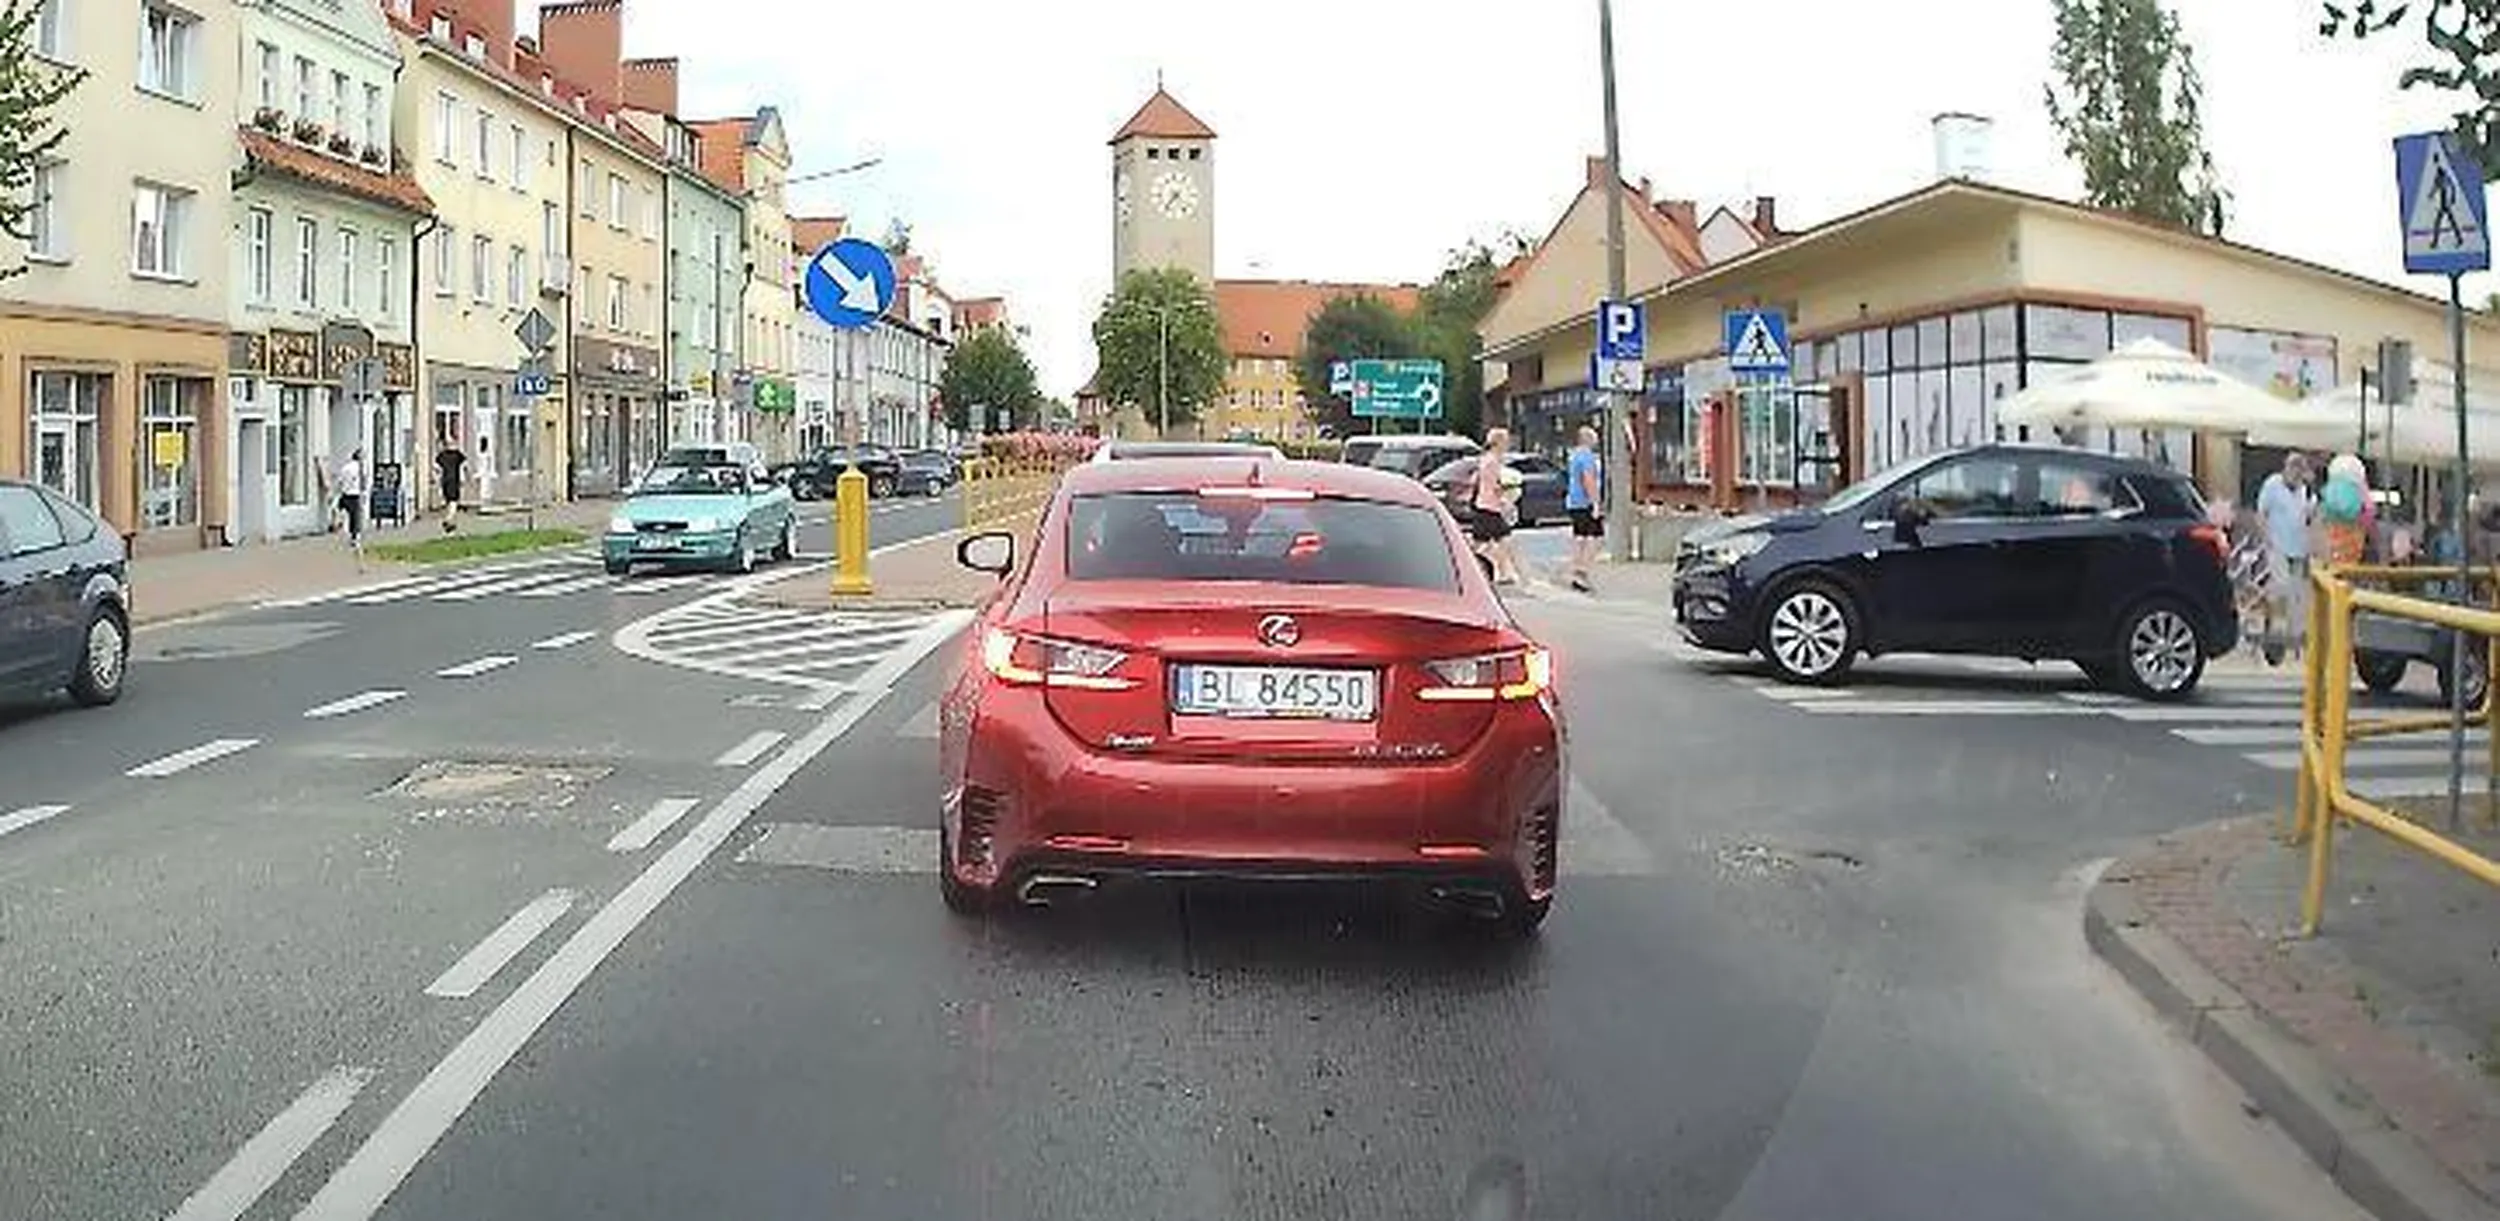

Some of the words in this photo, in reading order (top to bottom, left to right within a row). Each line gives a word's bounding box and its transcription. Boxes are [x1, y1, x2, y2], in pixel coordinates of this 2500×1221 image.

[1608, 305, 1634, 342] P
[1333, 362, 1349, 381] P
[1201, 669, 1241, 704] BL
[1257, 673, 1365, 710] 84550
